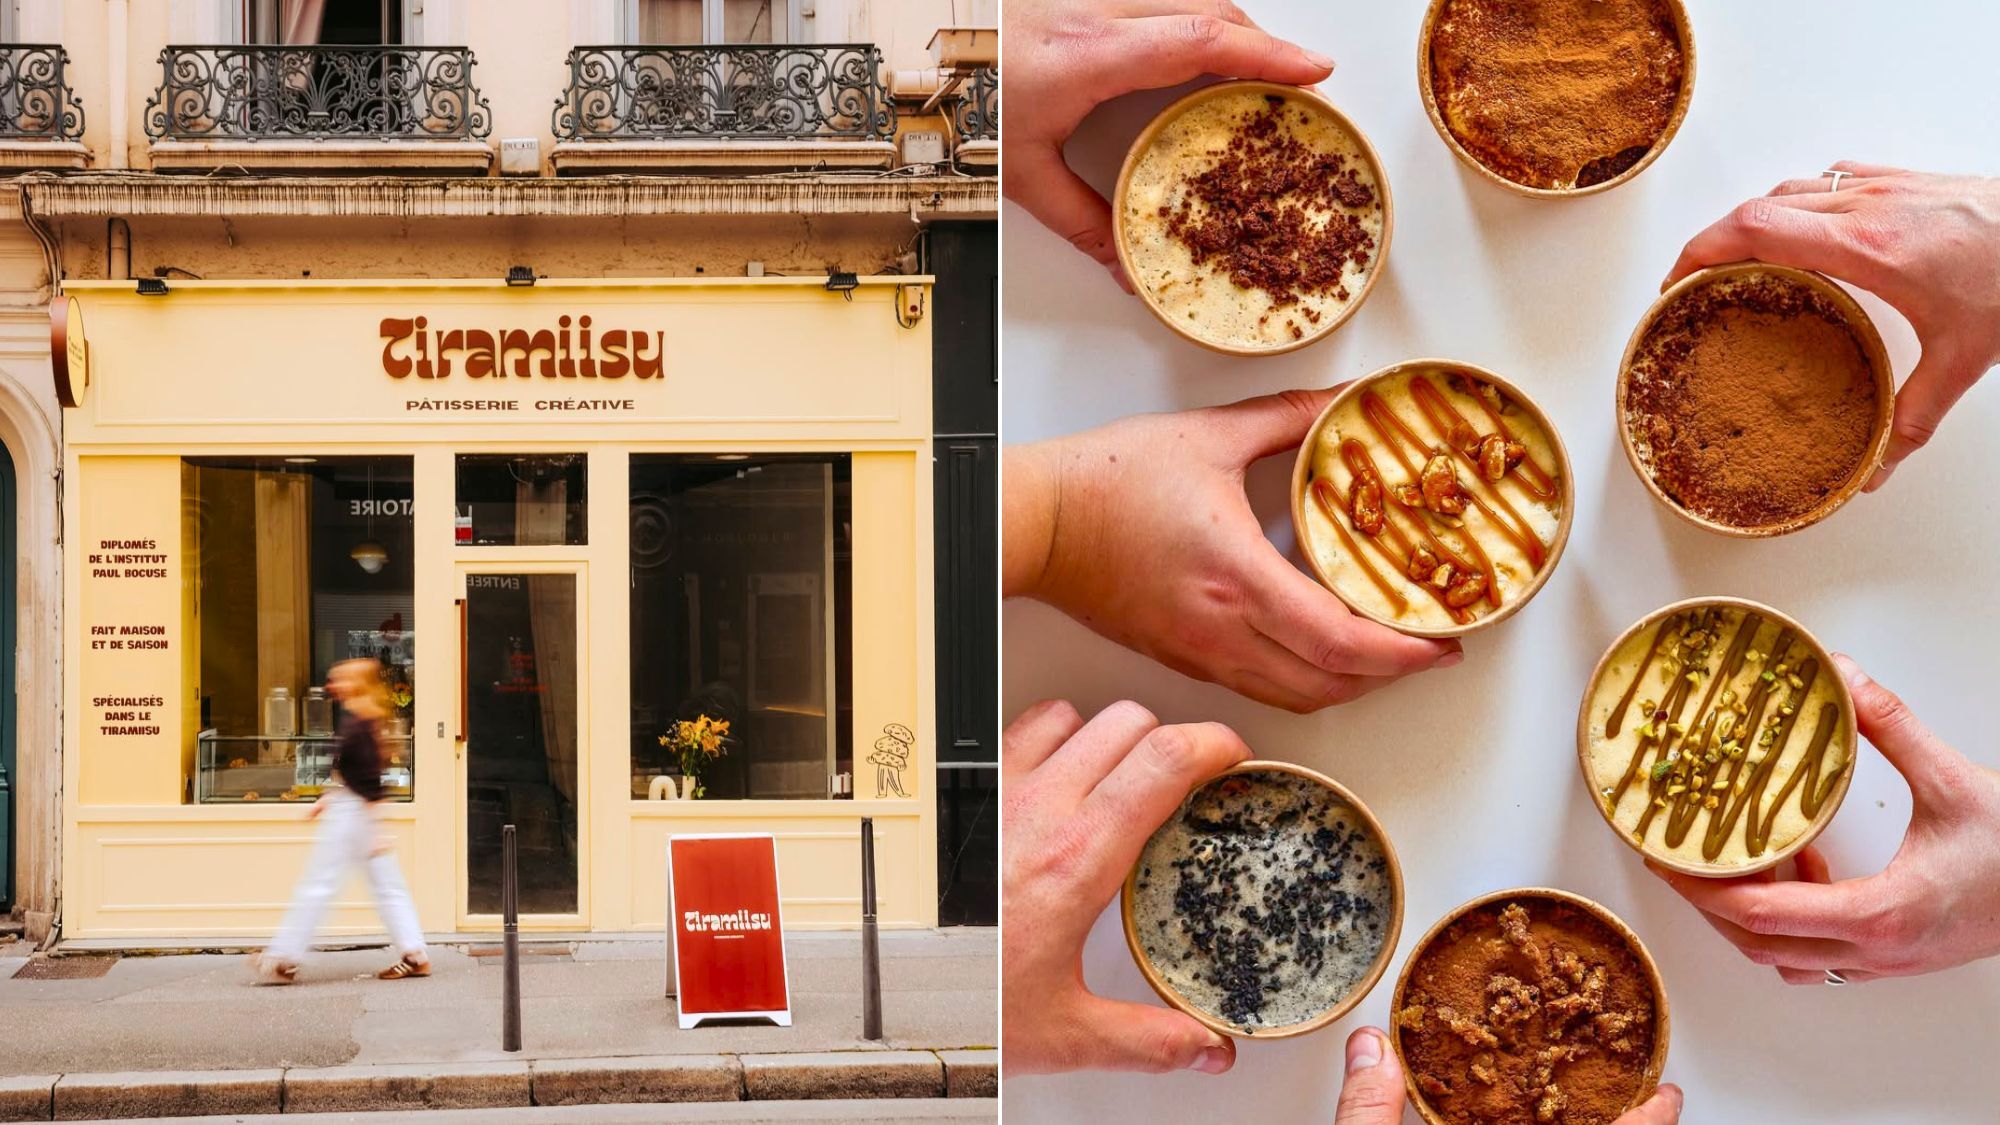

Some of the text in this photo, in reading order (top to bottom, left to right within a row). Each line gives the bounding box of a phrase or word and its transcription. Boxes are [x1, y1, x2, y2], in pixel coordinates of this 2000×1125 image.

[379, 314, 665, 379] Tiramiisu
[406, 396, 634, 411] PÂTISSERIE CRÉATIVE
[100, 537, 156, 550] DIPLOMÉS
[89, 554, 168, 564] DE L'INSTITUT
[93, 569, 168, 578] PAUL BOCUSE
[91, 626, 165, 635] FAIT MAISON
[92, 640, 169, 650] ET DE SAISON
[93, 694, 164, 707] SPÉCIALISÉS
[105, 711, 152, 721] DANS LE
[100, 726, 160, 736] TIRAMIISU
[684, 909, 772, 932] Tiramiisu
